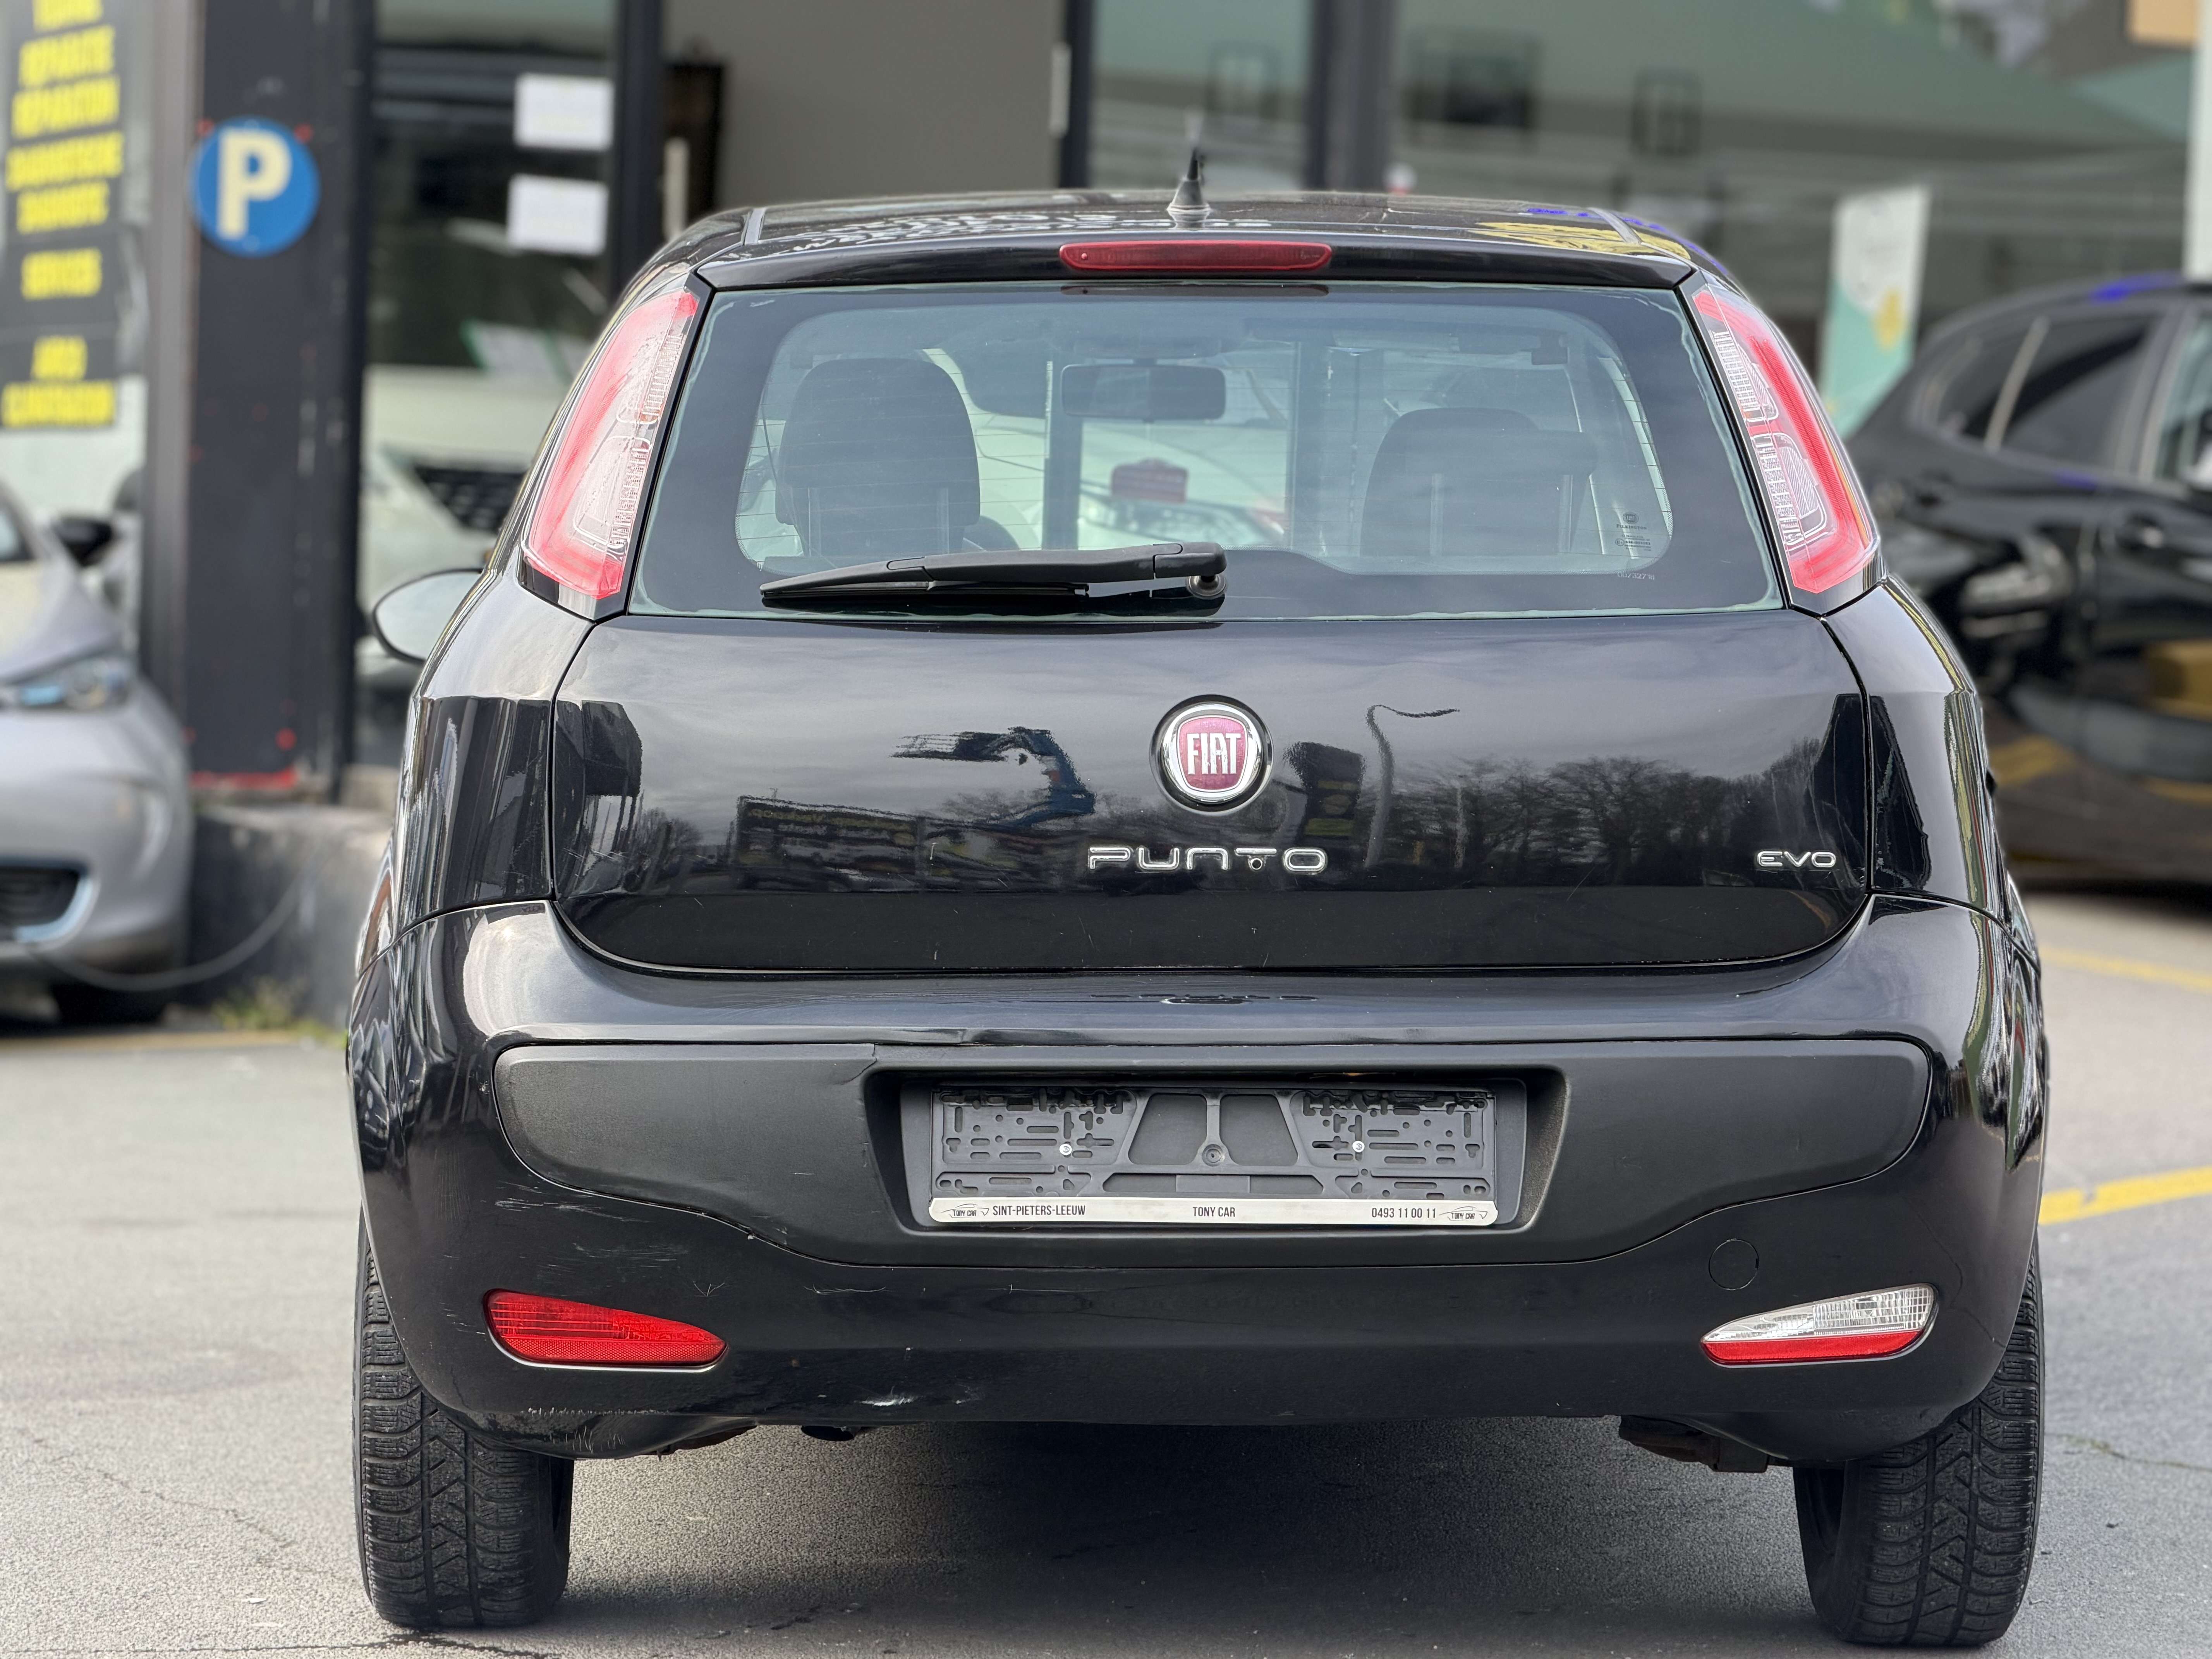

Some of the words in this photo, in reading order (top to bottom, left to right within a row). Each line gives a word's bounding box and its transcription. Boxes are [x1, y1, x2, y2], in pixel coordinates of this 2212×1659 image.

[218, 127, 292, 239] P
[1187, 733, 1241, 775] FIAT
[1089, 847, 1328, 872] PUNTO
[1757, 851, 1836, 867] EVO
[993, 1205, 1085, 1215] SINT-PIETERS-LEEUW
[1193, 1207, 1216, 1216] TONY
[1218, 1207, 1235, 1217] CAR
[1372, 1208, 1395, 1218] 0493
[1398, 1208, 1408, 1218] 11
[1411, 1208, 1422, 1218] 00
[1426, 1208, 1436, 1218] 11
